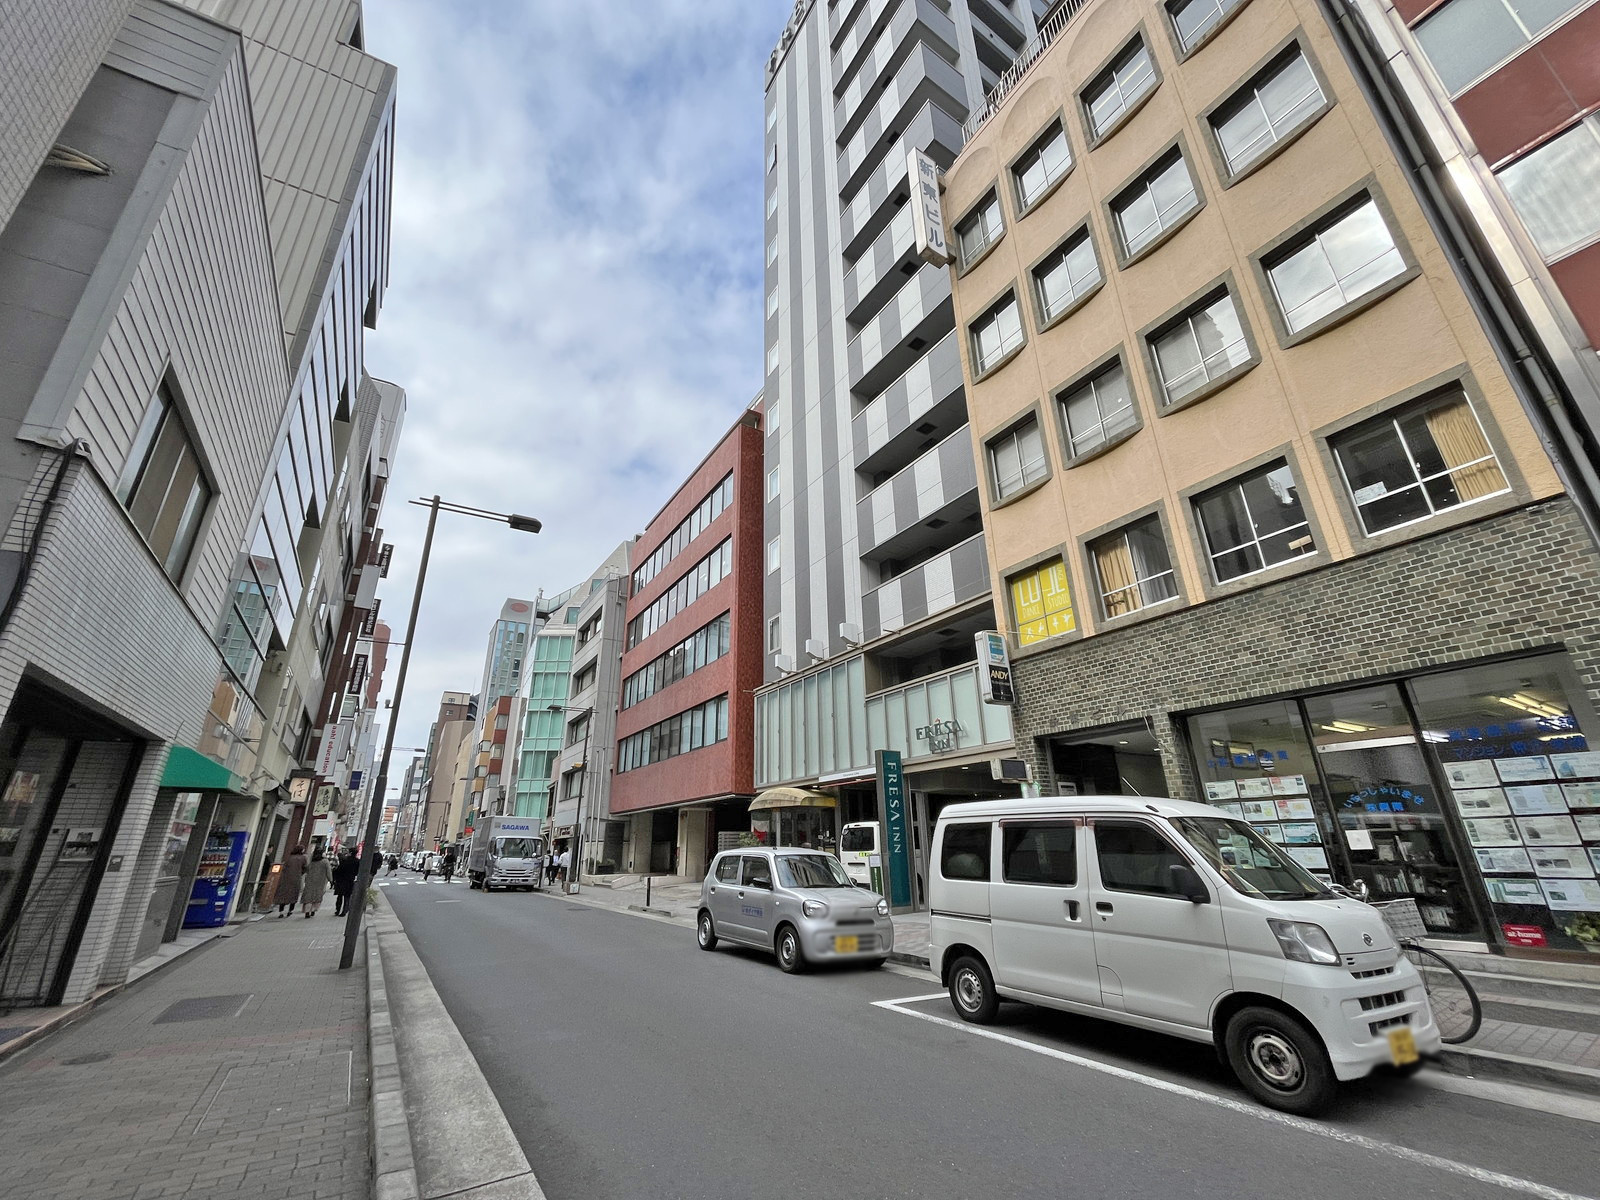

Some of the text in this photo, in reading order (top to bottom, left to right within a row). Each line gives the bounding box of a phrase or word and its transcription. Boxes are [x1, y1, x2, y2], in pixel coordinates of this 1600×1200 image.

[990, 669, 1009, 680] ANDY
[915, 719, 963, 741] FRESA
[321, 740, 334, 774] education
[887, 761, 902, 853] FRESA INN
[1343, 786, 1425, 806] いらっしゃいませ
